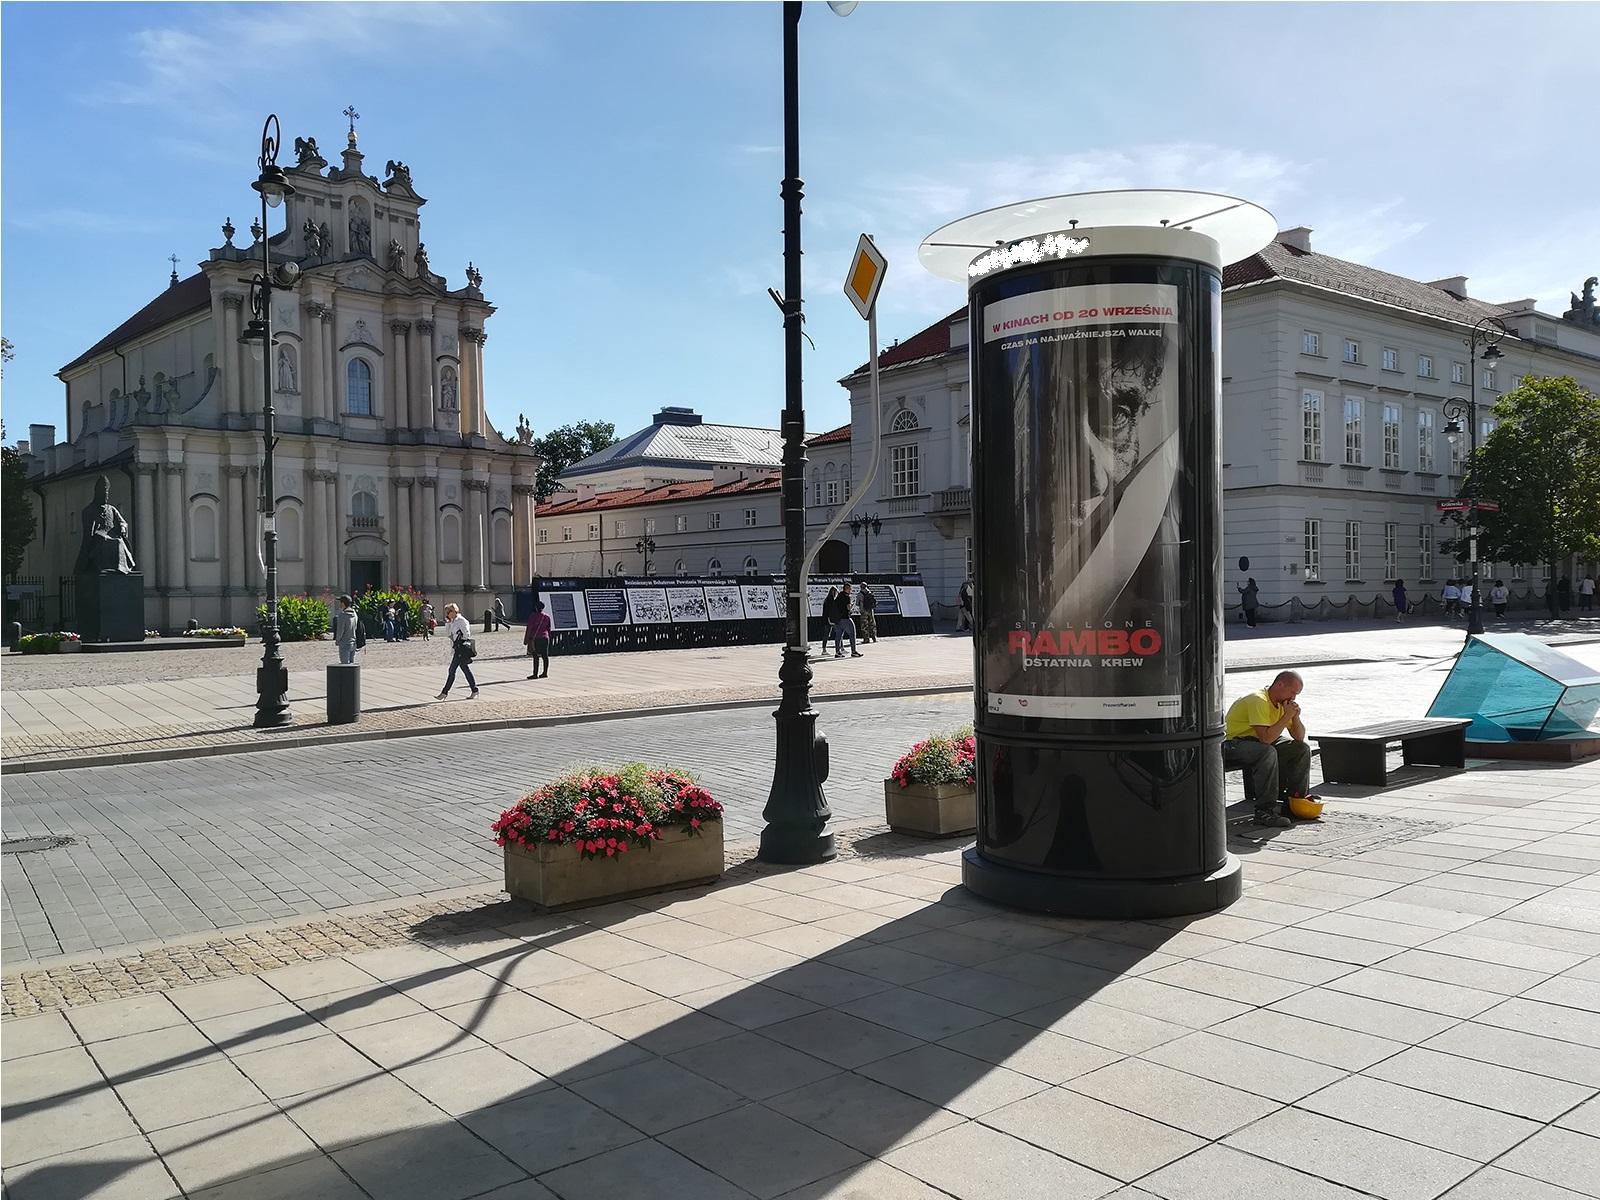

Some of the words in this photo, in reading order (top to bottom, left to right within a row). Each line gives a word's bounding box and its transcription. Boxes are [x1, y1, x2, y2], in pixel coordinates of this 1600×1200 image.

[992, 323, 1001, 334] W
[1003, 313, 1049, 330] KINACH
[1053, 310, 1075, 321] OD
[1078, 308, 1099, 318] 20
[1103, 304, 1173, 317] WRZEŚNIA
[1001, 339, 1024, 351] CZAS
[1025, 337, 1038, 347] NA
[1040, 328, 1126, 344] NAJWAŻNIEJSZĄ
[1128, 328, 1162, 338] WALKĘ
[1015, 619, 1153, 629] STALLONE
[1008, 628, 1163, 657] RAMBO
[1023, 658, 1093, 668] OSTATNIA
[1101, 658, 1144, 668] KREW
